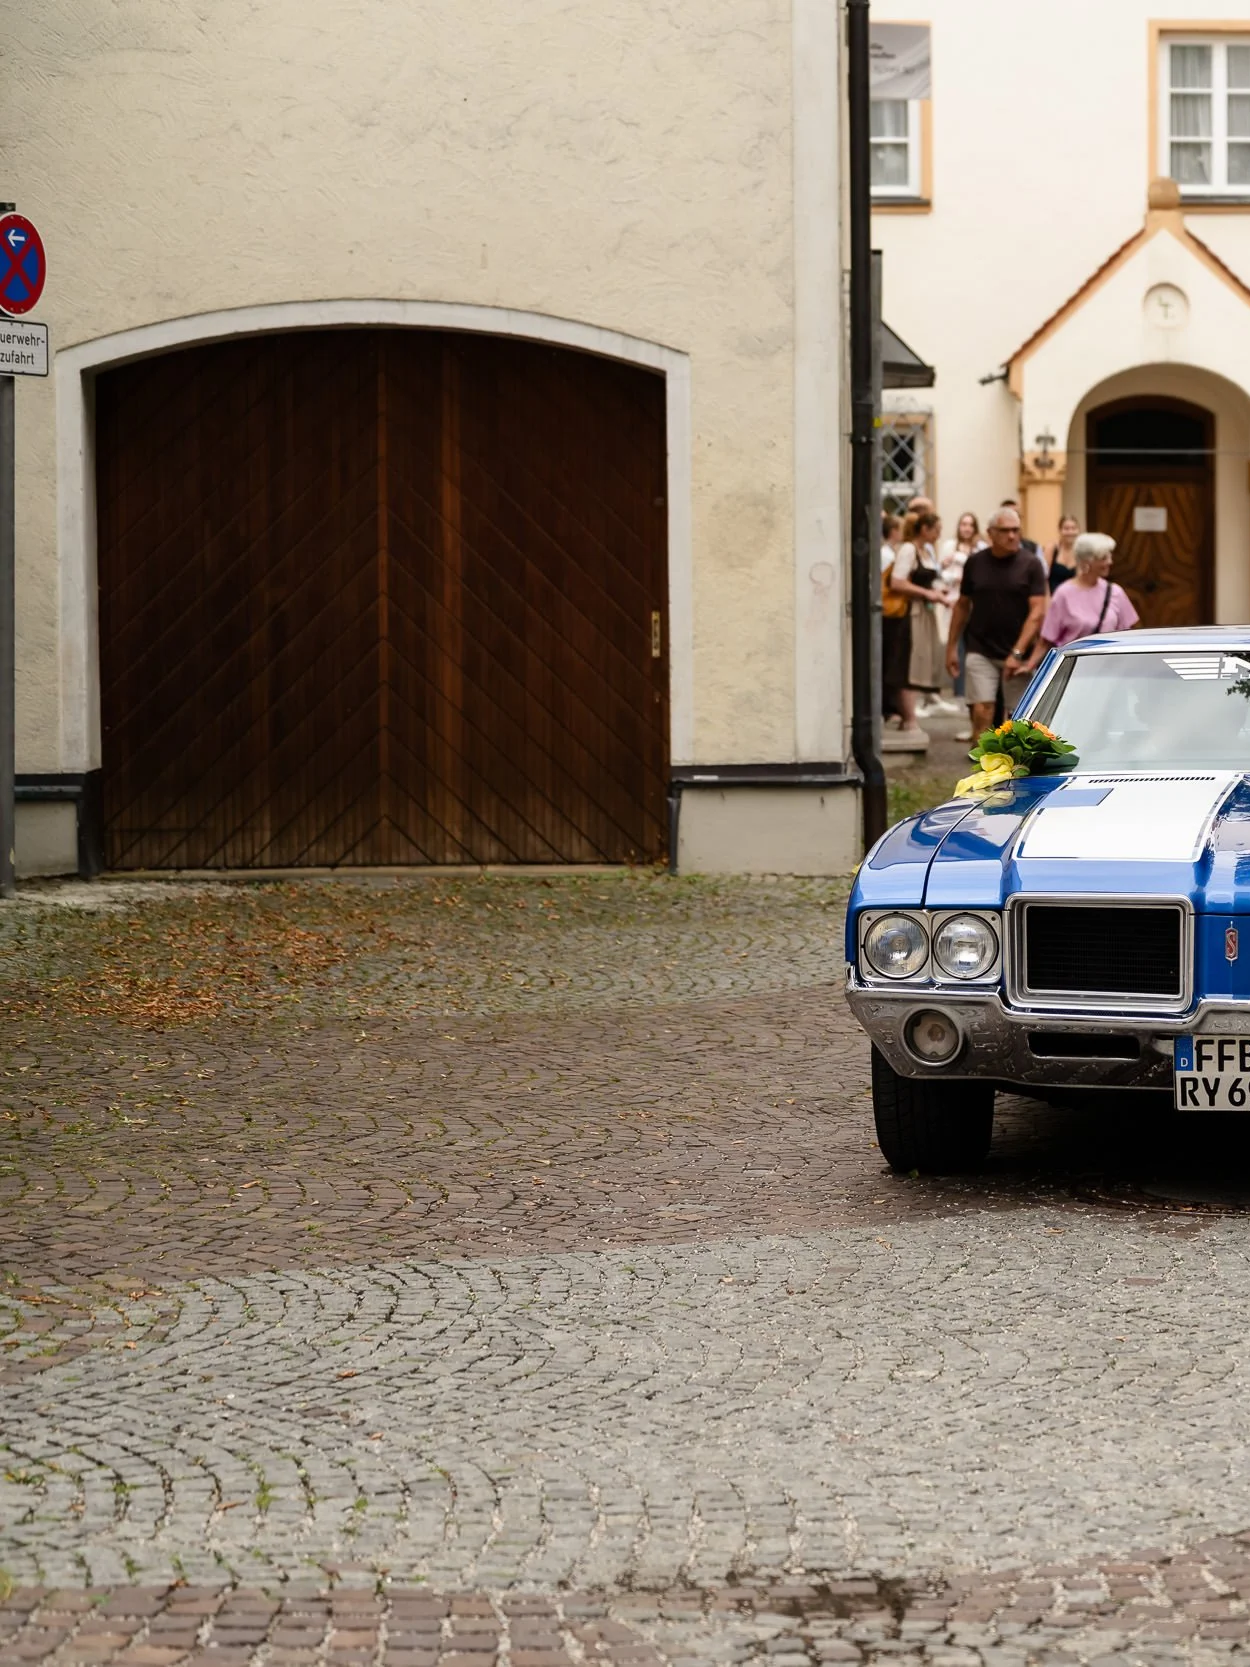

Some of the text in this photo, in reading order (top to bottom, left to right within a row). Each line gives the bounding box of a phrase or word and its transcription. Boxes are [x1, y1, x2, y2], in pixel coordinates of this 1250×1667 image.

[0, 332, 45, 346] uerwehr-
[0, 350, 34, 365] zufahrt
[1180, 1058, 1188, 1067] D
[1180, 1077, 1220, 1107] RY
